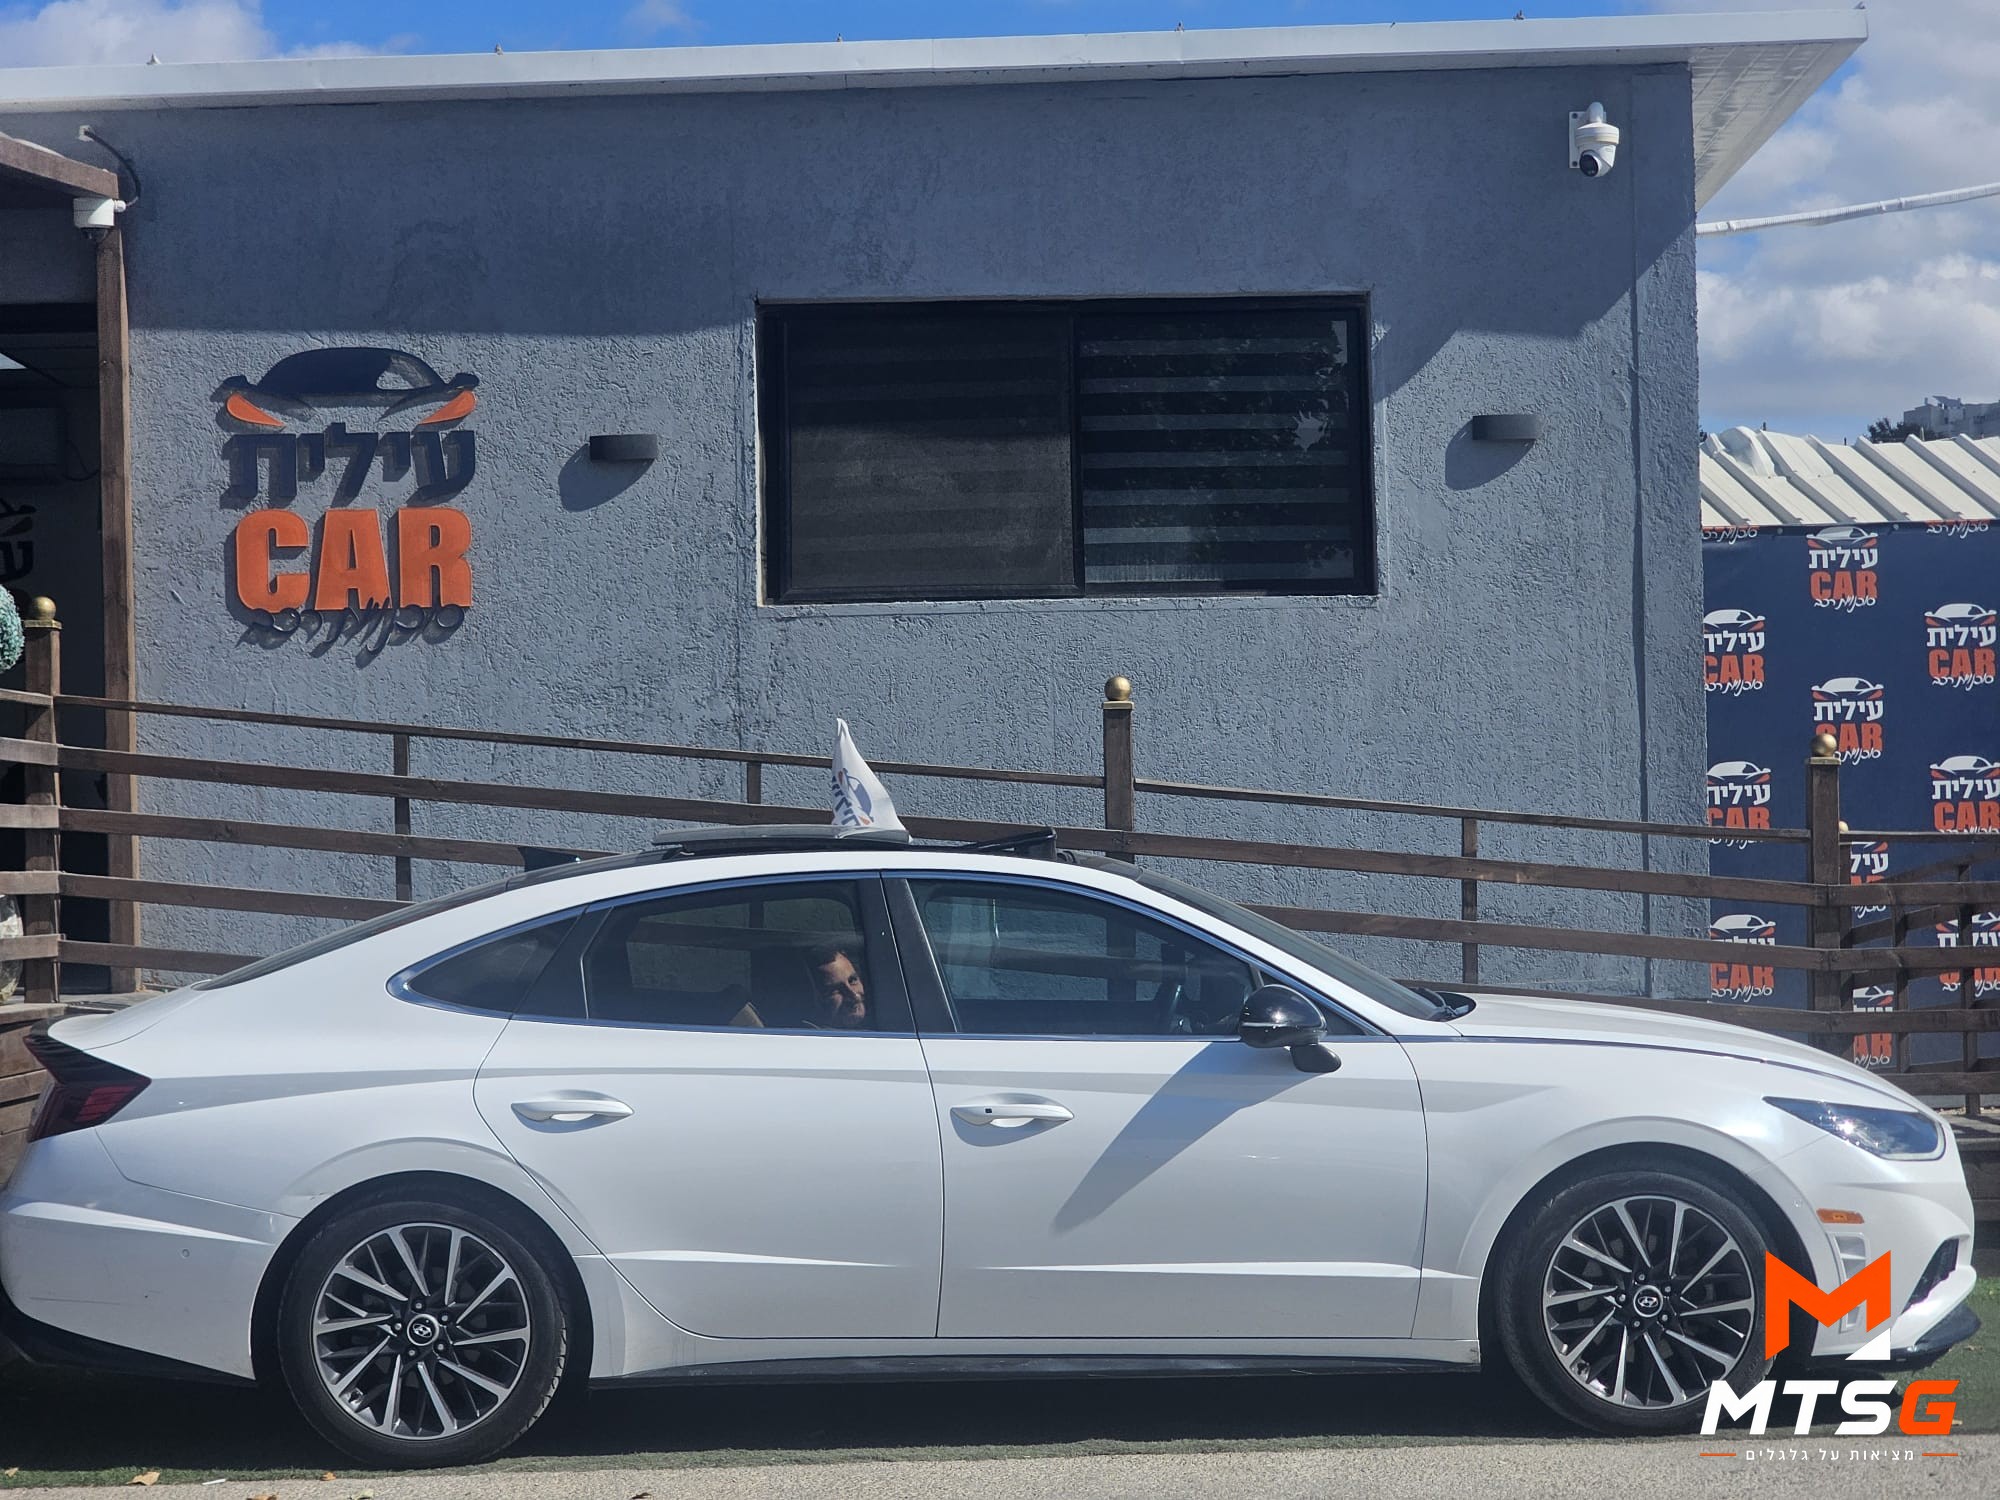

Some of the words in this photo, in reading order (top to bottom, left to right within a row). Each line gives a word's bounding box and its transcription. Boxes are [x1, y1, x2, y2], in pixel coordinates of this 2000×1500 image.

[229, 423, 475, 500] עילית
[235, 507, 473, 613] CAR
[1808, 546, 1878, 569] עילית
[1810, 570, 1878, 600] CAR
[1926, 624, 1997, 647] עילית
[1929, 648, 1996, 679] CAR
[1813, 698, 1884, 721] עילית
[1932, 777, 2000, 800] עילית
[1934, 801, 2000, 832] CAR
